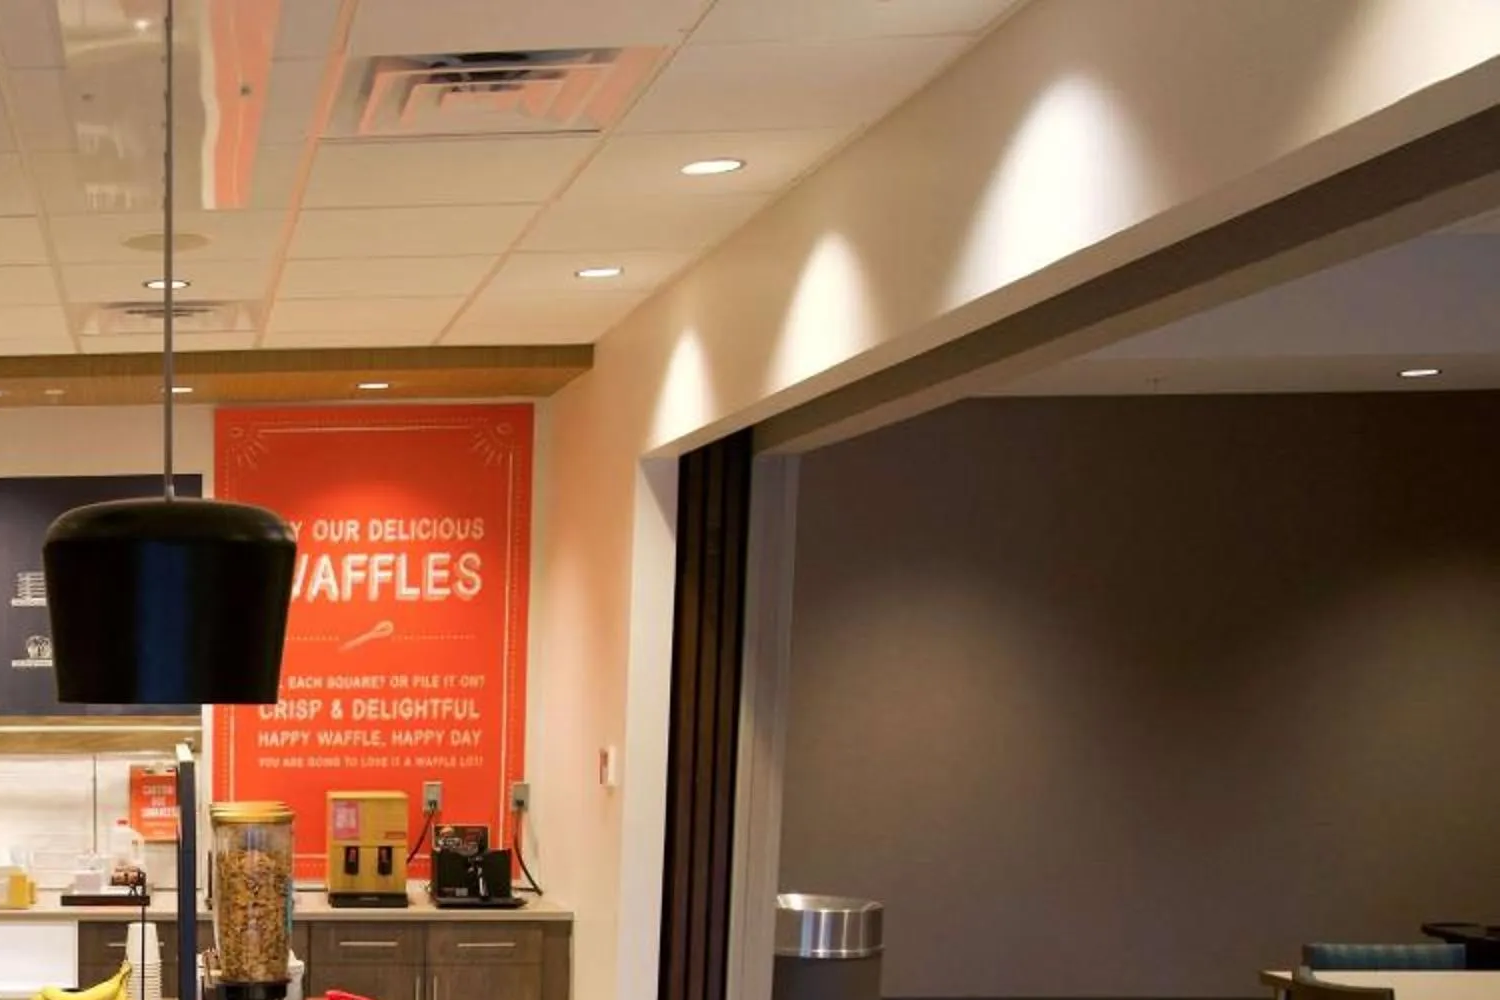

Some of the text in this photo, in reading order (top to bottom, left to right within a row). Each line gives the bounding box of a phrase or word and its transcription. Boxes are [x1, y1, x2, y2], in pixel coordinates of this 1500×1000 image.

[312, 518, 361, 542] OUR
[368, 517, 485, 542] DELICIOUS
[288, 675, 322, 689] EACH
[258, 697, 481, 721] CRISP & DELIGHTFUL
[258, 731, 310, 749] HAPPY
[391, 729, 445, 748] HAPPY
[450, 729, 483, 748] DAY
